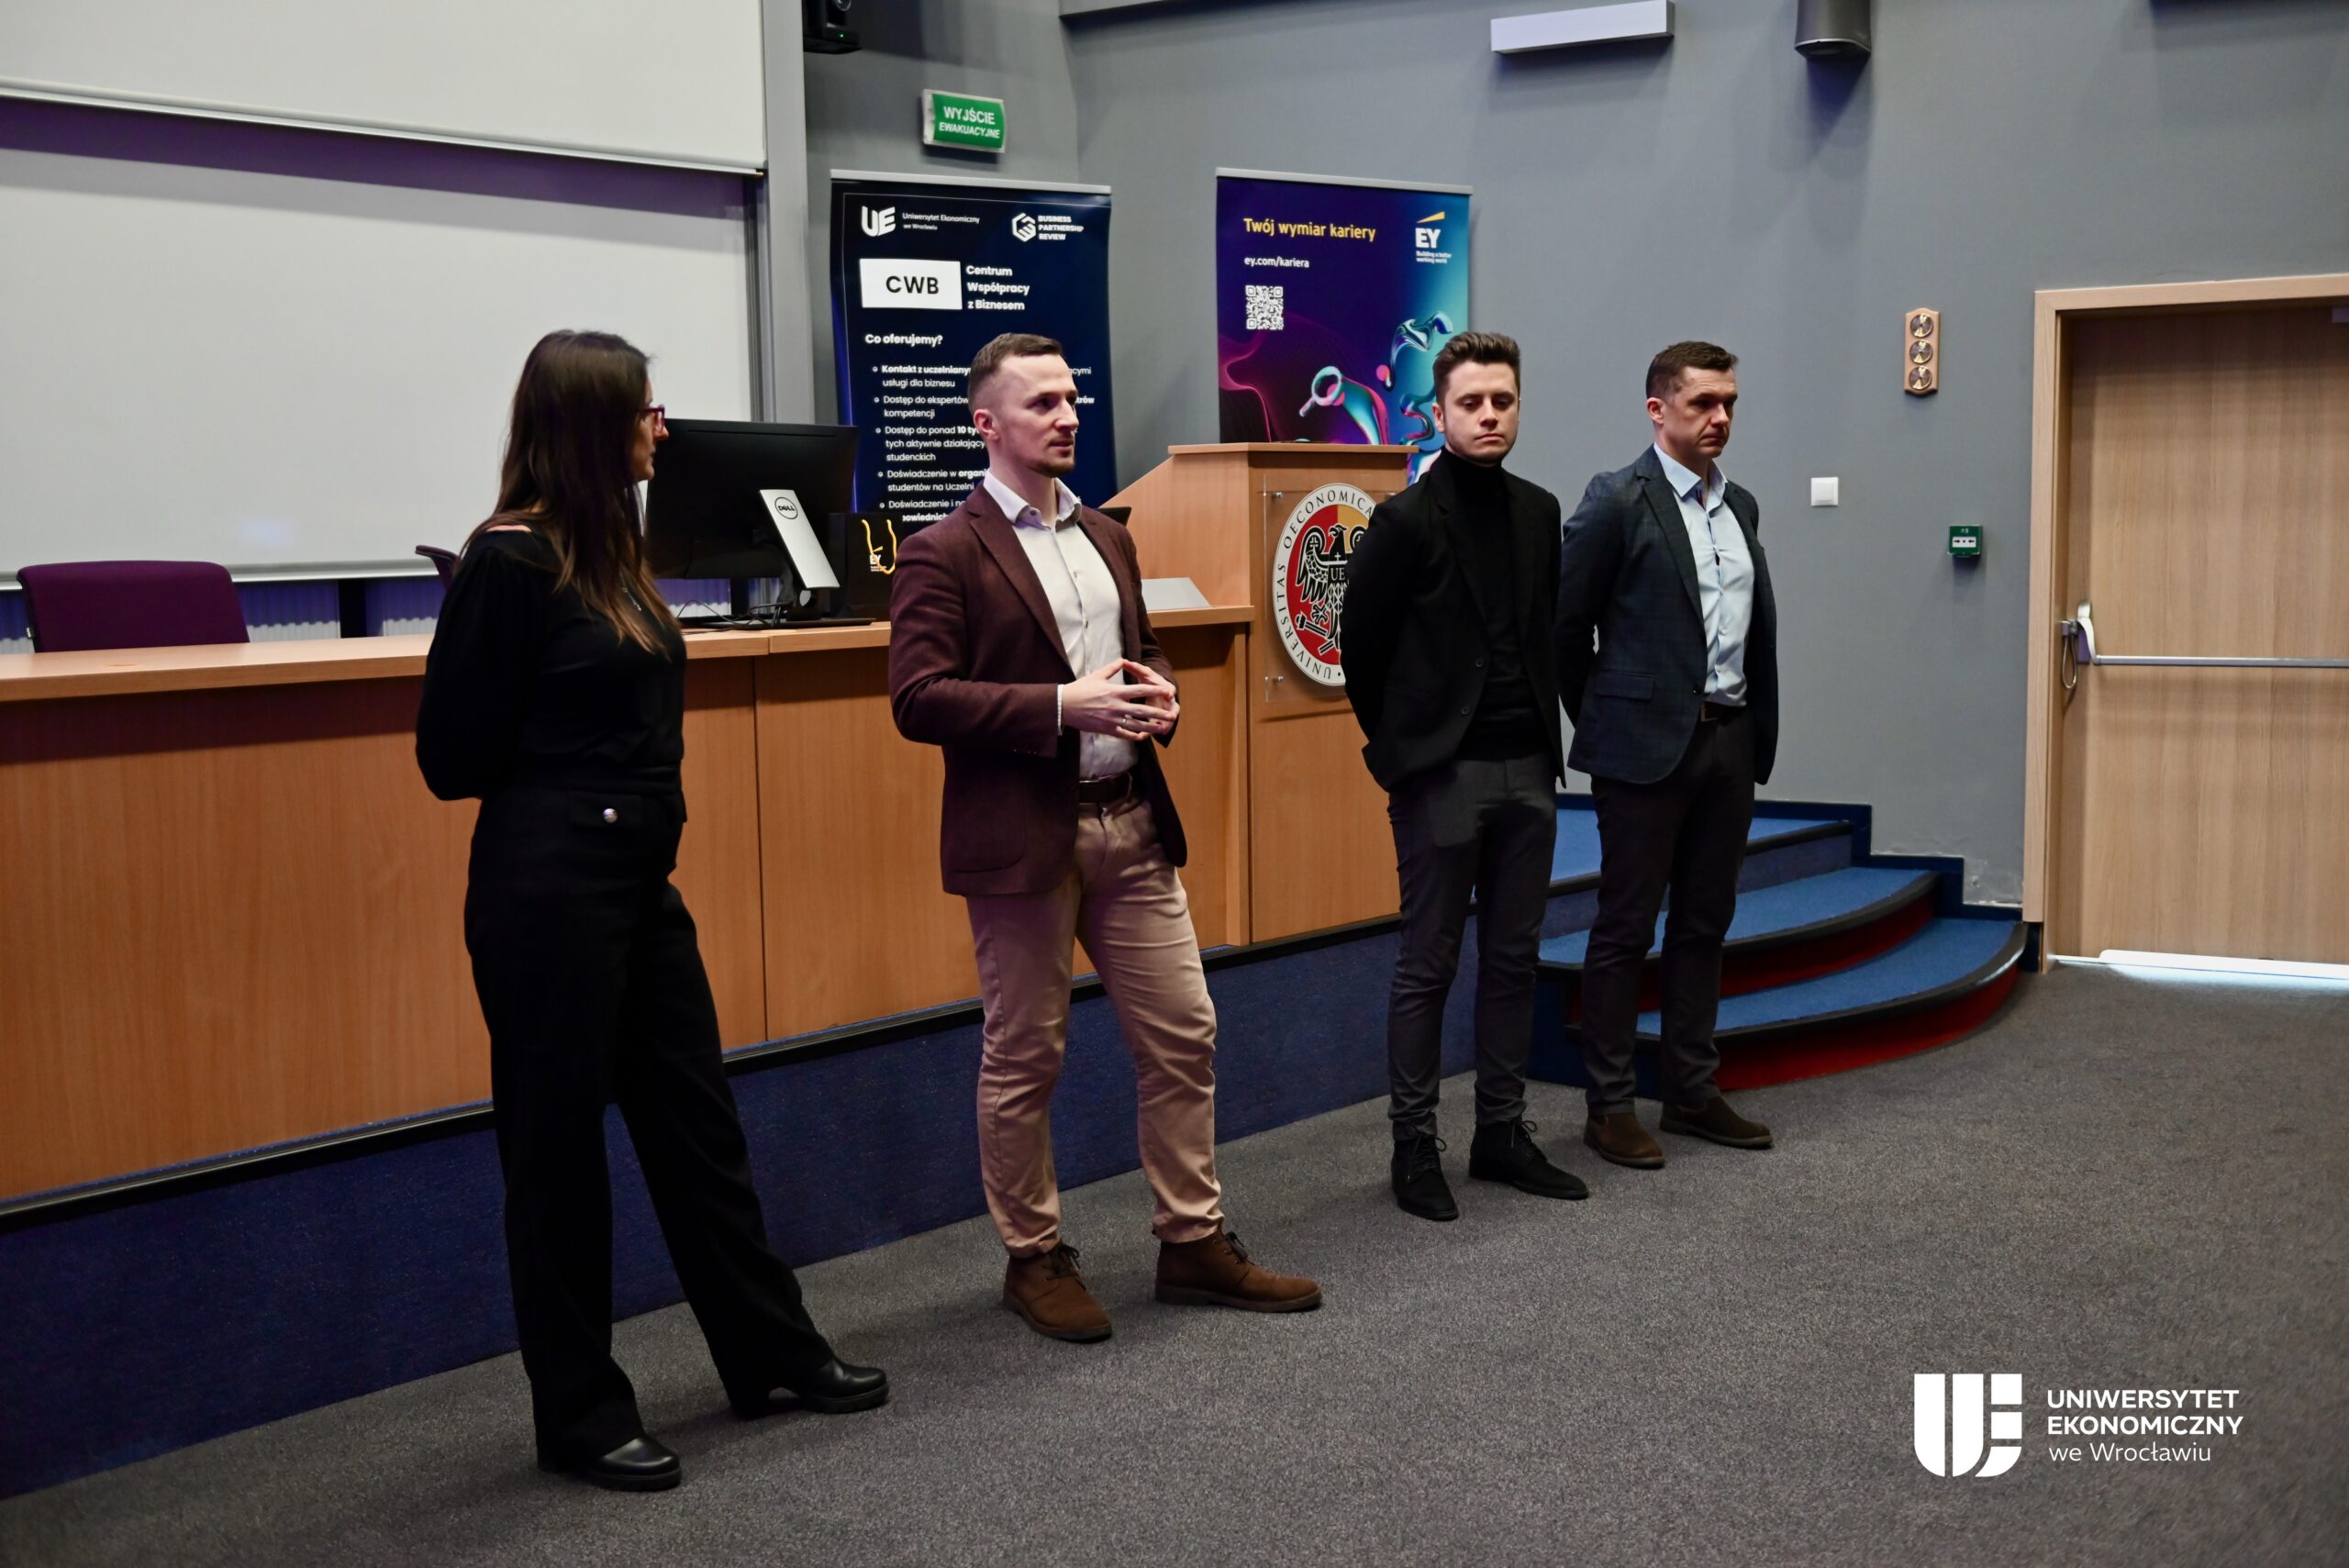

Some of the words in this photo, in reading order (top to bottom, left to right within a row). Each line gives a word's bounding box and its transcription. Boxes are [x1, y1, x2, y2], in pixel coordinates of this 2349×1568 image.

[943, 106, 996, 125] WYJŚCIE
[939, 122, 1001, 139] EWAKUACYJNE
[902, 212, 940, 221] Uniwersytet
[941, 214, 980, 224] Ekonomiczny
[1038, 215, 1072, 223] BUSINESS
[1038, 224, 1084, 232] PARTNERSHIP
[1243, 218, 1275, 237] Twój
[1278, 221, 1326, 238] wymiar
[1330, 224, 1375, 242] kariery
[1416, 228, 1441, 249] EY
[1244, 256, 1309, 268] ey.com/kariera
[966, 265, 1013, 276] Centrum
[885, 276, 939, 295] CWB
[967, 282, 1030, 295] Współpracy
[975, 299, 1025, 310] Biznesem
[865, 334, 881, 344] Co
[883, 333, 943, 347] oferujemy?
[882, 365, 917, 373] Kontakt
[923, 365, 971, 376] uczelniany
[883, 379, 908, 389] usługi
[909, 379, 924, 387] dla
[925, 379, 955, 387] biznesu
[884, 395, 914, 406] Dostęp
[915, 395, 926, 404] do
[928, 395, 969, 406] ekspertów
[884, 409, 935, 419] kompetencji
[885, 426, 915, 436] Dostęp
[916, 426, 927, 434] do
[929, 426, 956, 436] ponad
[957, 426, 966, 434] 10
[885, 439, 904, 450] tych
[906, 439, 941, 450] aktywnie
[943, 439, 985, 450] działający
[886, 452, 936, 462] studenckich
[887, 469, 948, 478] Doświadczenie
[958, 468, 987, 479] organi
[888, 483, 930, 492] studentów
[945, 483, 974, 491] Uczelni
[888, 499, 949, 508] Doświadczenie
[1284, 489, 1373, 549] OECONOMICA
[1330, 568, 1346, 580] UE
[1277, 564, 1331, 679] UNIVERSITAS
